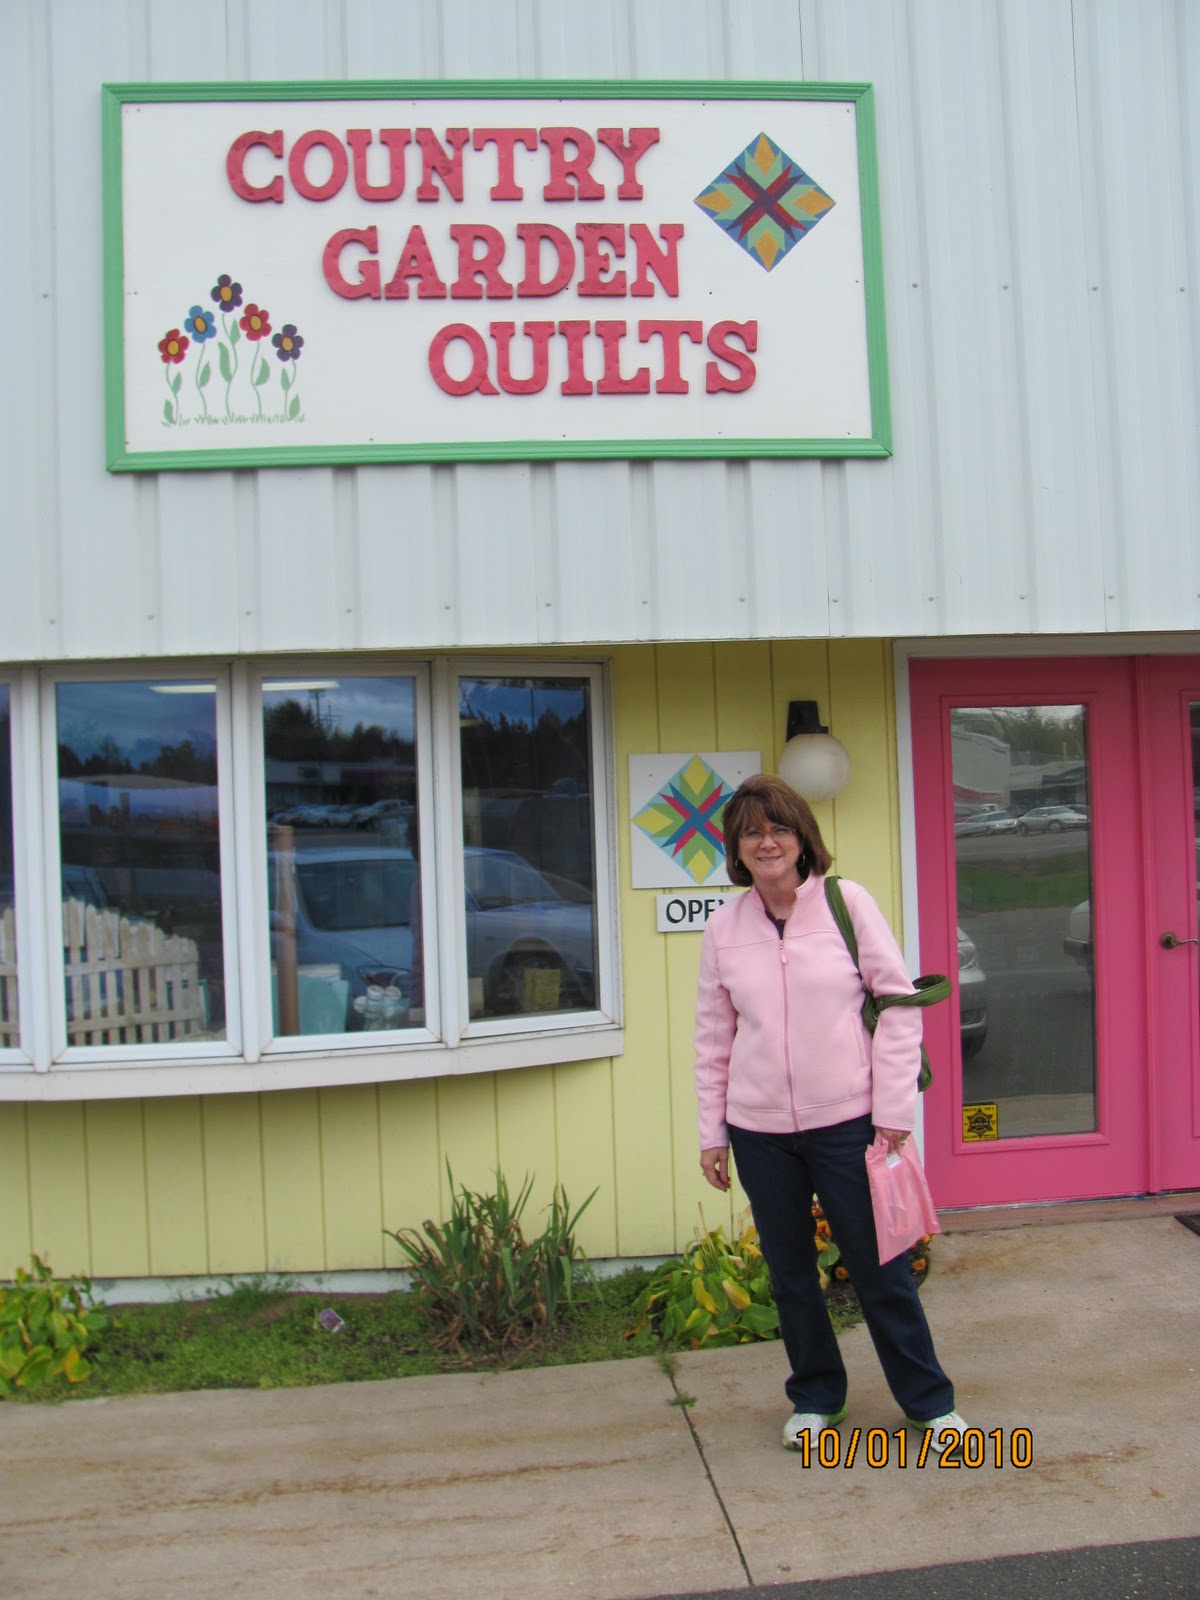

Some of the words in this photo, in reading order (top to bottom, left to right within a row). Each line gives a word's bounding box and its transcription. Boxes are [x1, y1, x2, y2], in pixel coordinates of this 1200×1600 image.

[227, 127, 660, 202] COUNTRY
[323, 223, 684, 299] GARDEN
[429, 320, 758, 396] QUILTS
[666, 898, 725, 924] OPE
